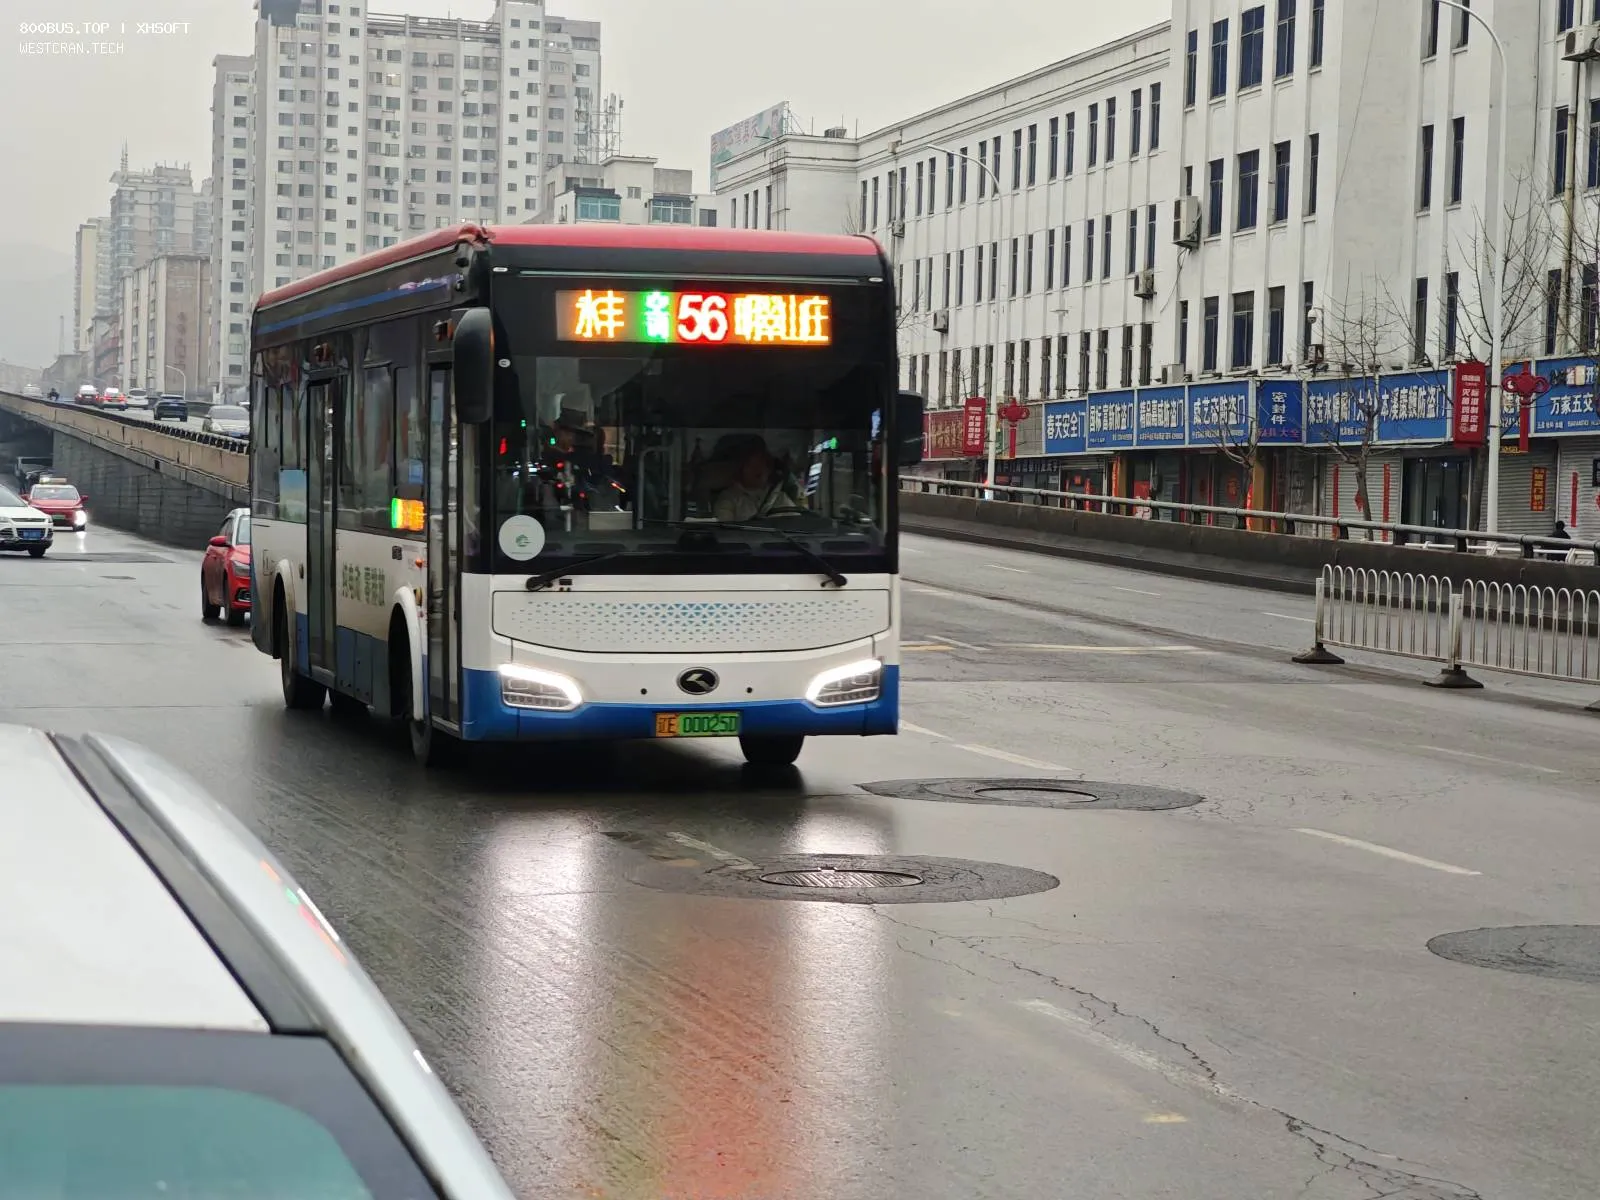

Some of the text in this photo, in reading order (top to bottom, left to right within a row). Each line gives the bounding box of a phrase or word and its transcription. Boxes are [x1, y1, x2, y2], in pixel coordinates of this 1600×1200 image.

[677, 294, 728, 341] 56
[1046, 410, 1086, 440] 春天安全门
[1270, 391, 1288, 425] 密封件
